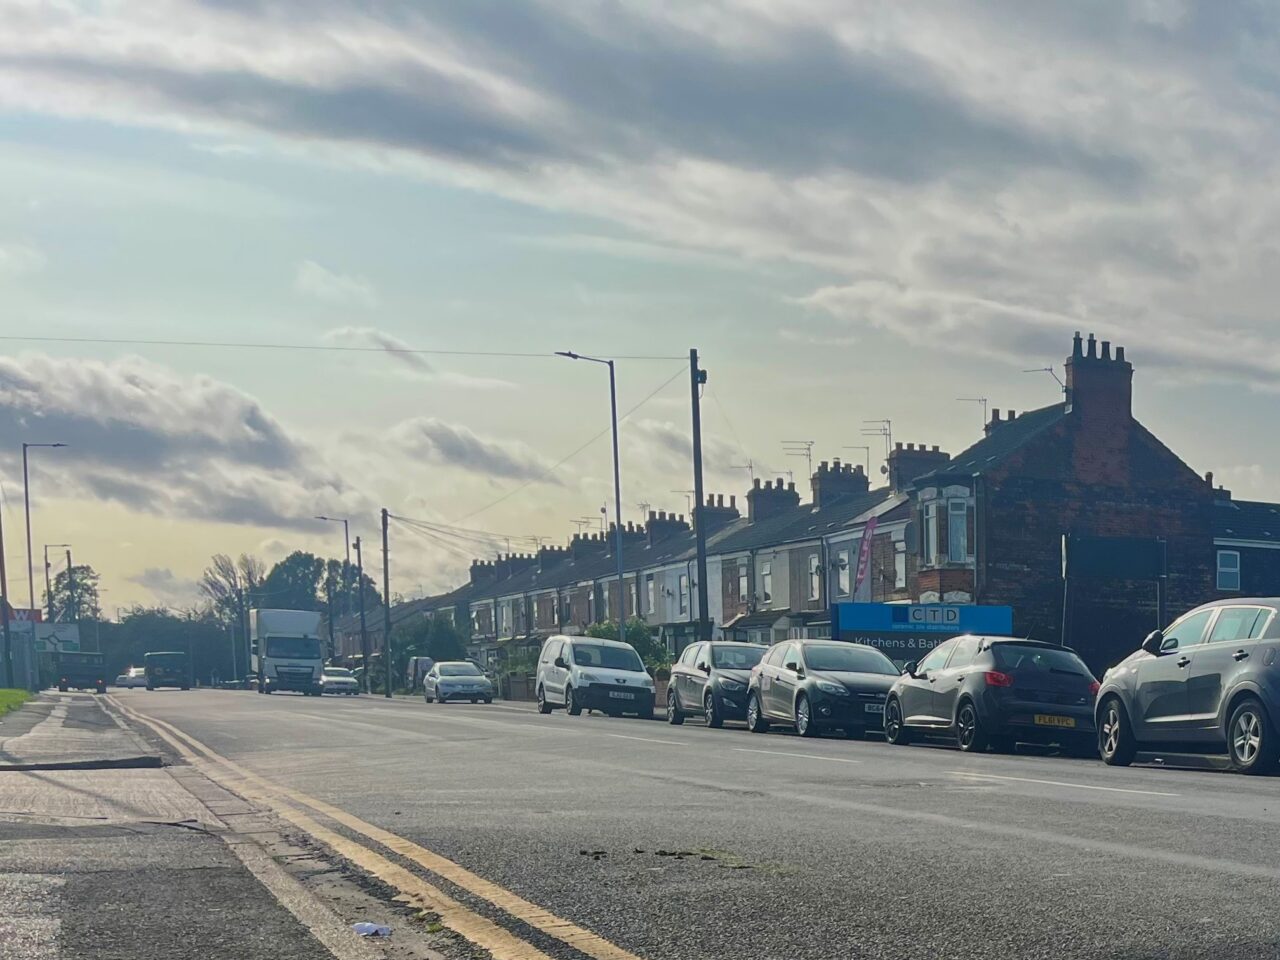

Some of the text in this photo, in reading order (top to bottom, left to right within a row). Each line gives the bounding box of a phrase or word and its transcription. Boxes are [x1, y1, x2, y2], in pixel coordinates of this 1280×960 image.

[912, 608, 957, 622] CTD
[855, 637, 906, 648] Kitchens
[908, 638, 916, 649] &
